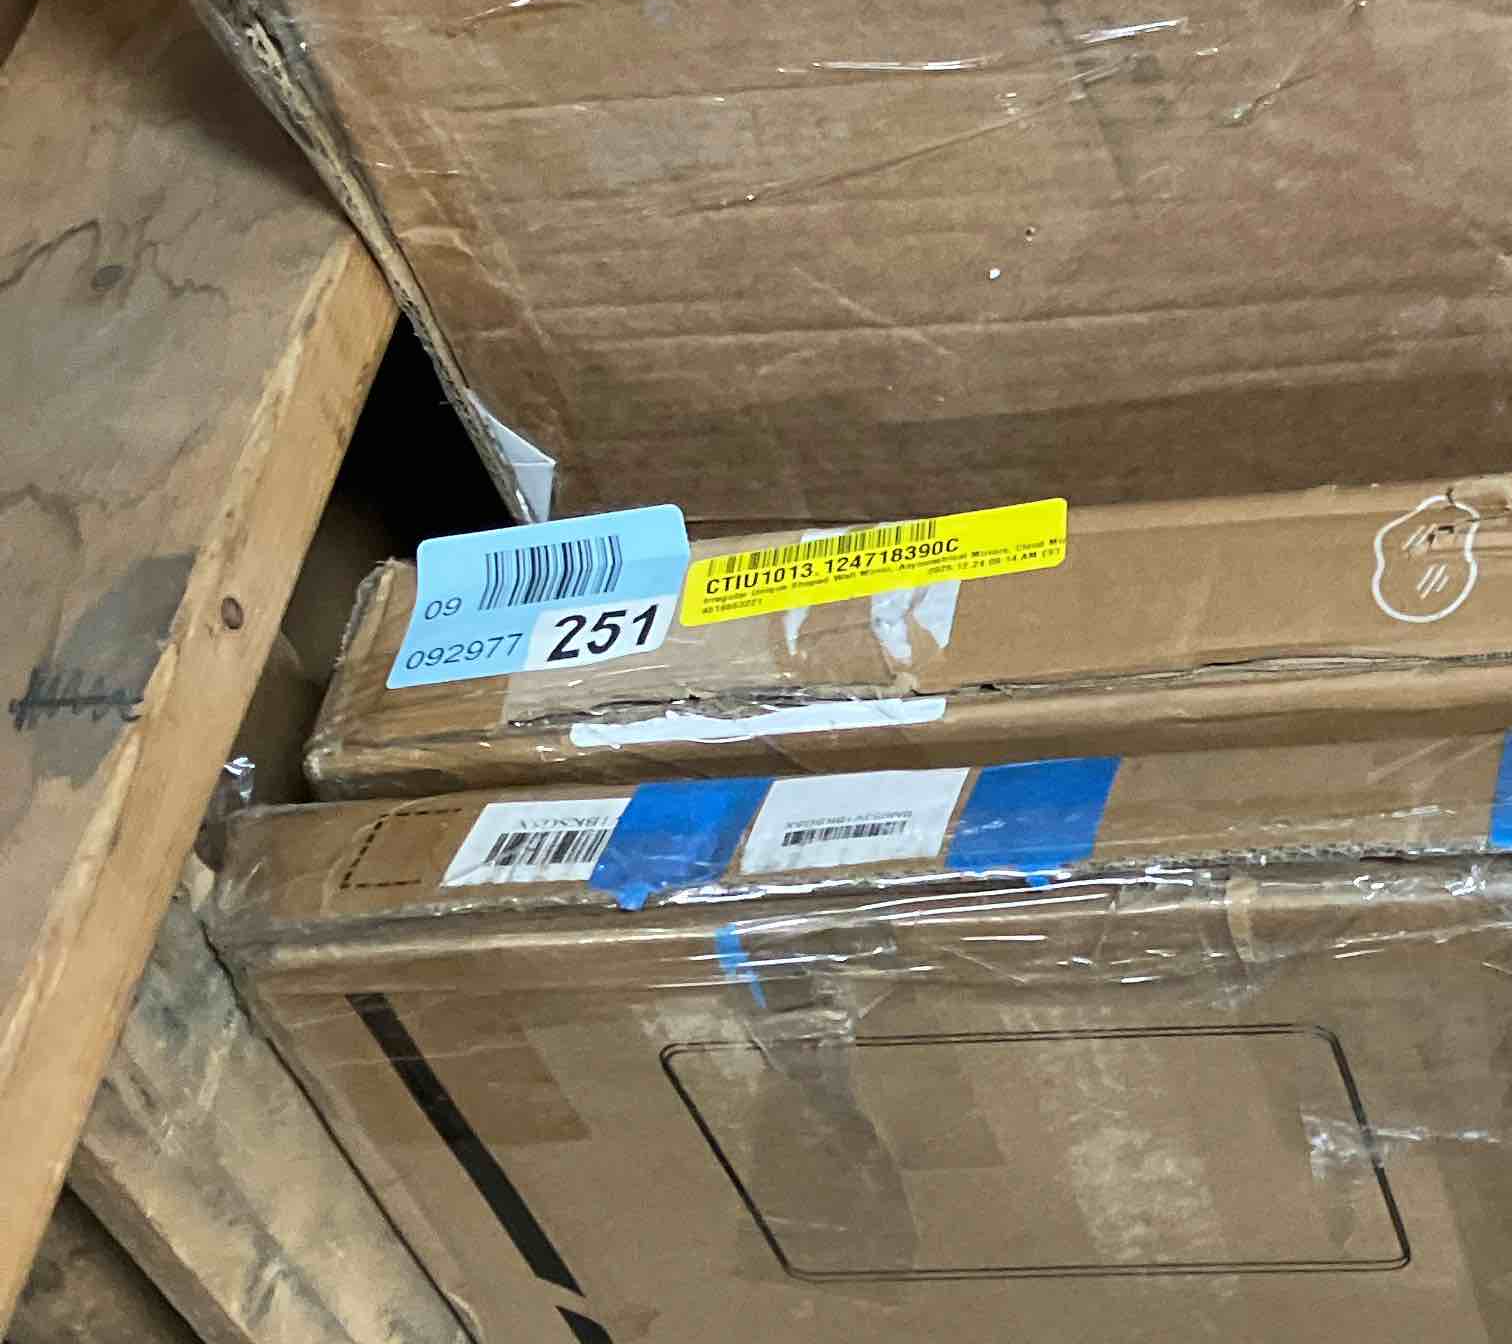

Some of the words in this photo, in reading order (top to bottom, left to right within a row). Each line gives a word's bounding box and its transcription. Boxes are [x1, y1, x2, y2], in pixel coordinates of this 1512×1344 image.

[424, 596, 463, 622] 09
[404, 632, 525, 670] 092977
[545, 603, 660, 662] 251
